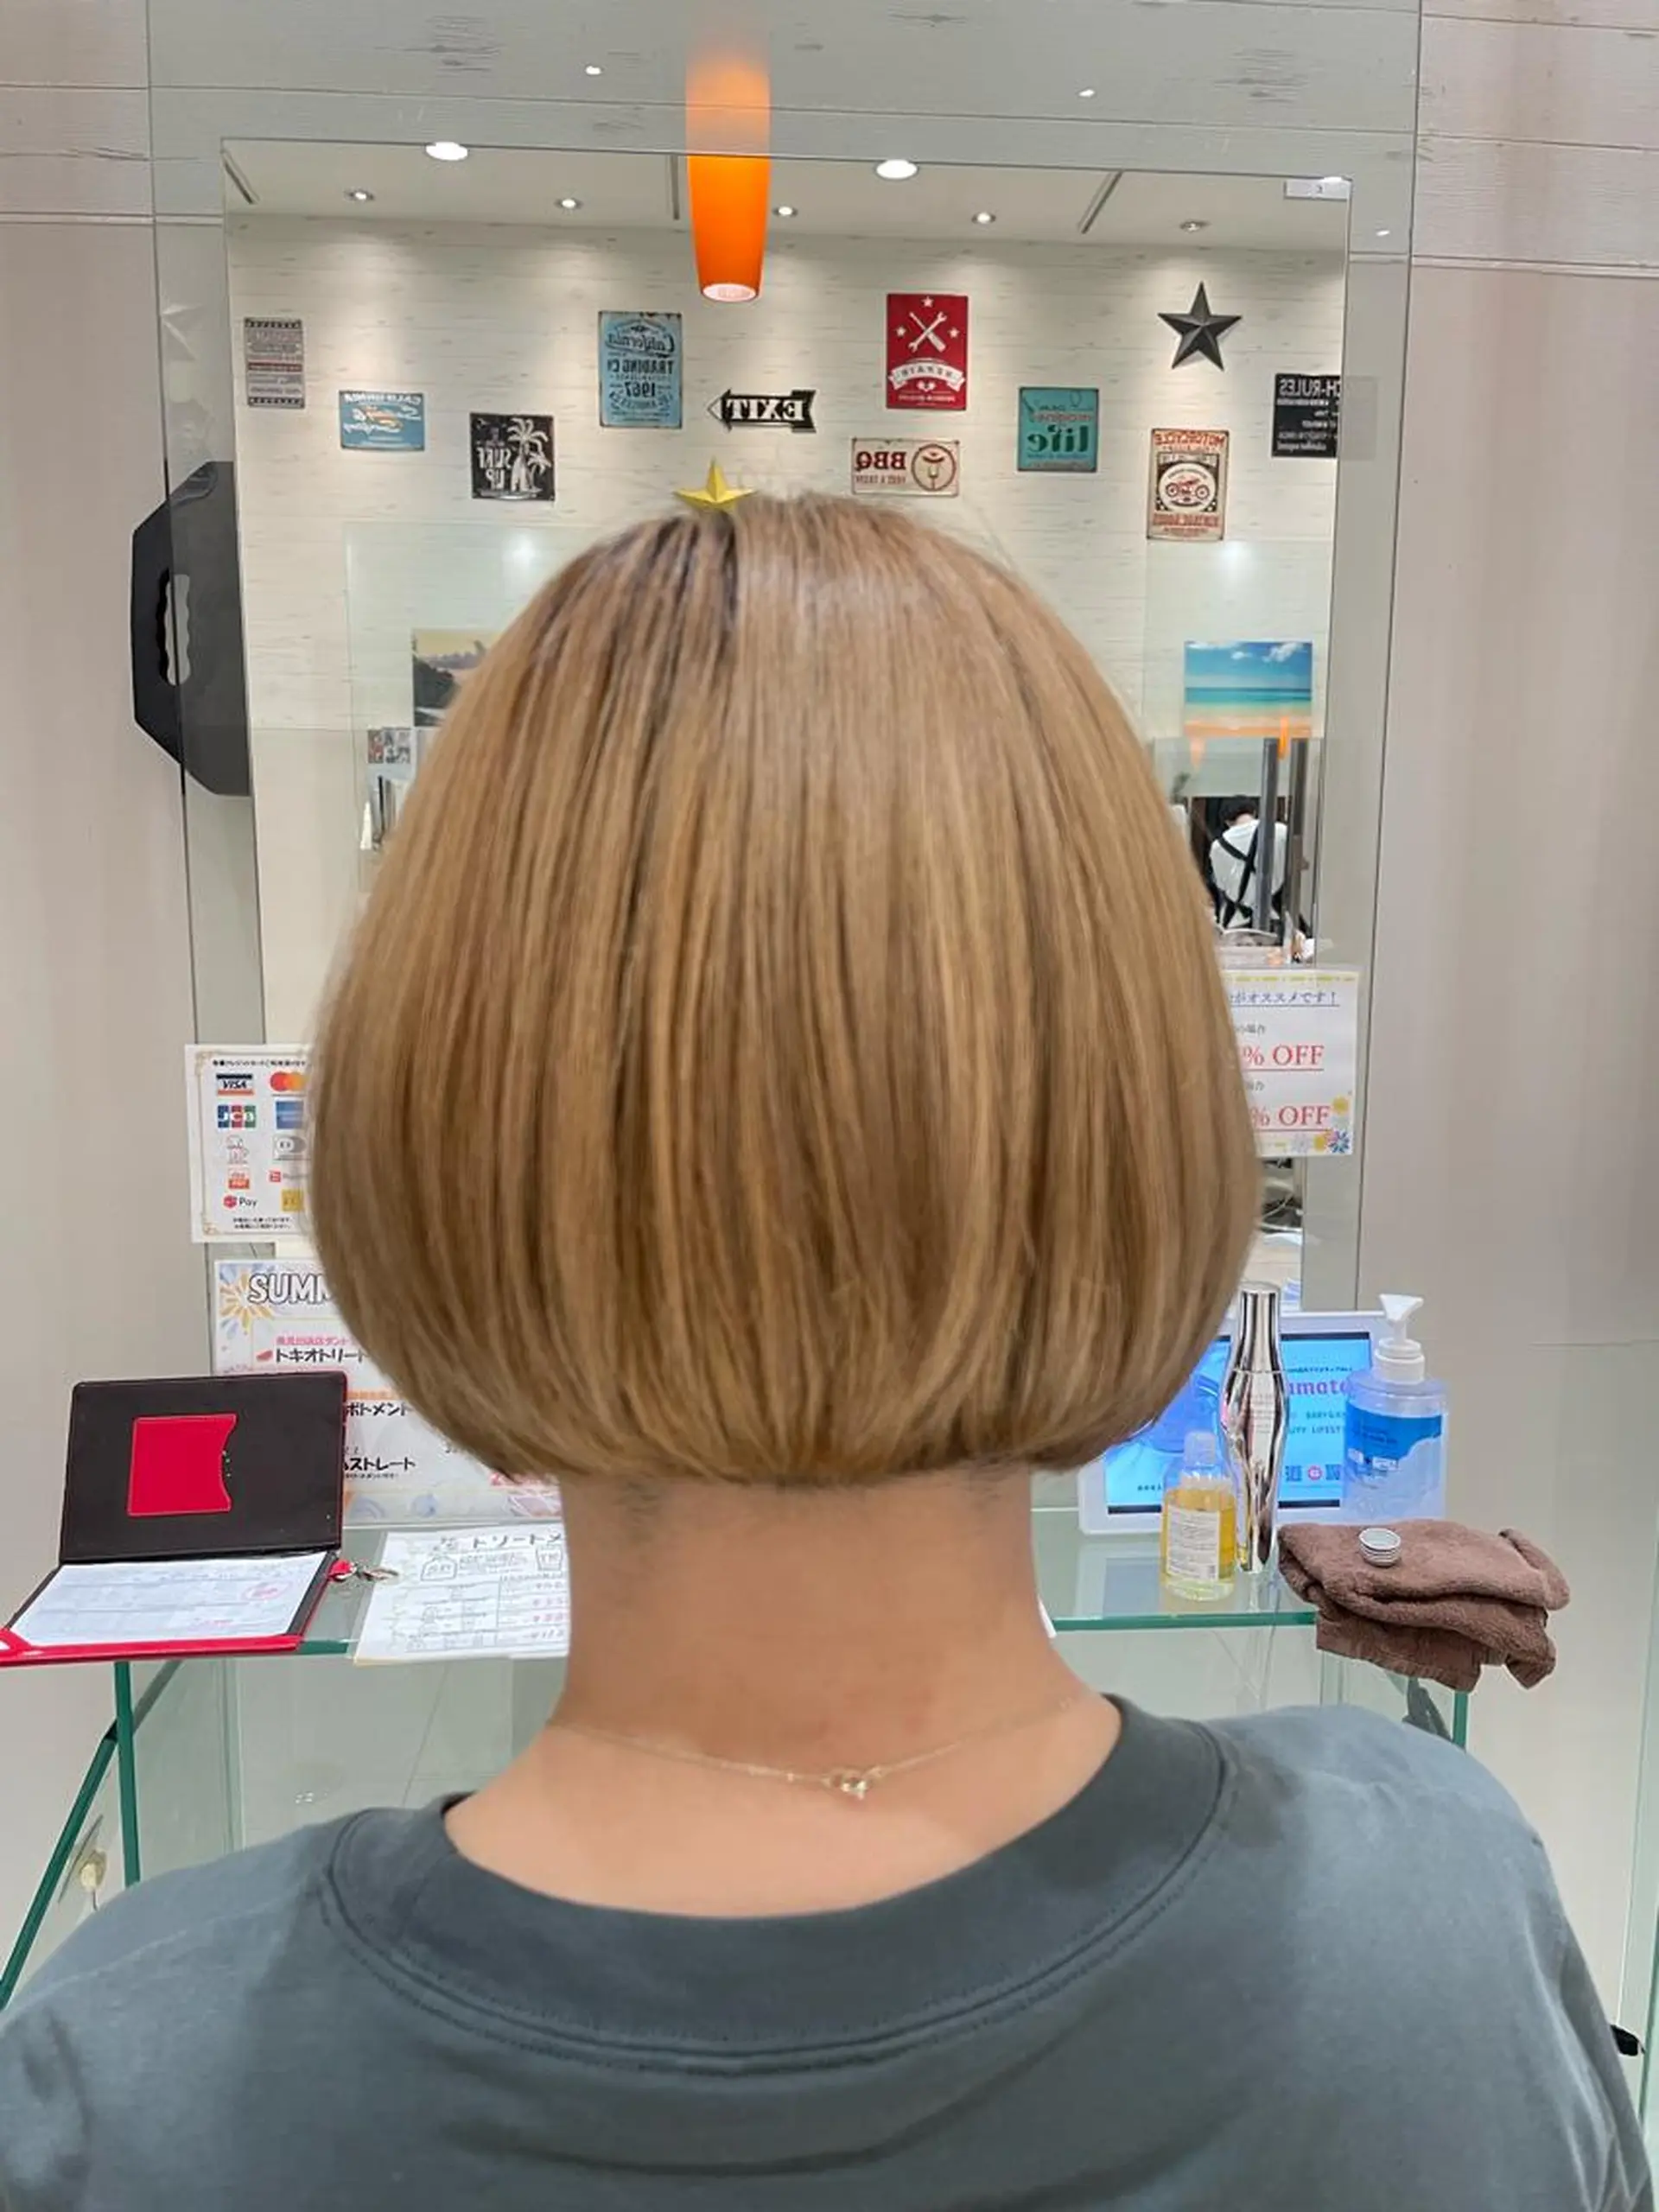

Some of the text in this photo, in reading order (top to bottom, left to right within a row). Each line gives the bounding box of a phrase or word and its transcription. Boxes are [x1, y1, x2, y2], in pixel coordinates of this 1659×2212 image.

[1273, 1045, 1325, 1065] OFF
[223, 1079, 247, 1090] VISA
[1279, 1106, 1331, 1126] OFF
[239, 1197, 257, 1208] Pay
